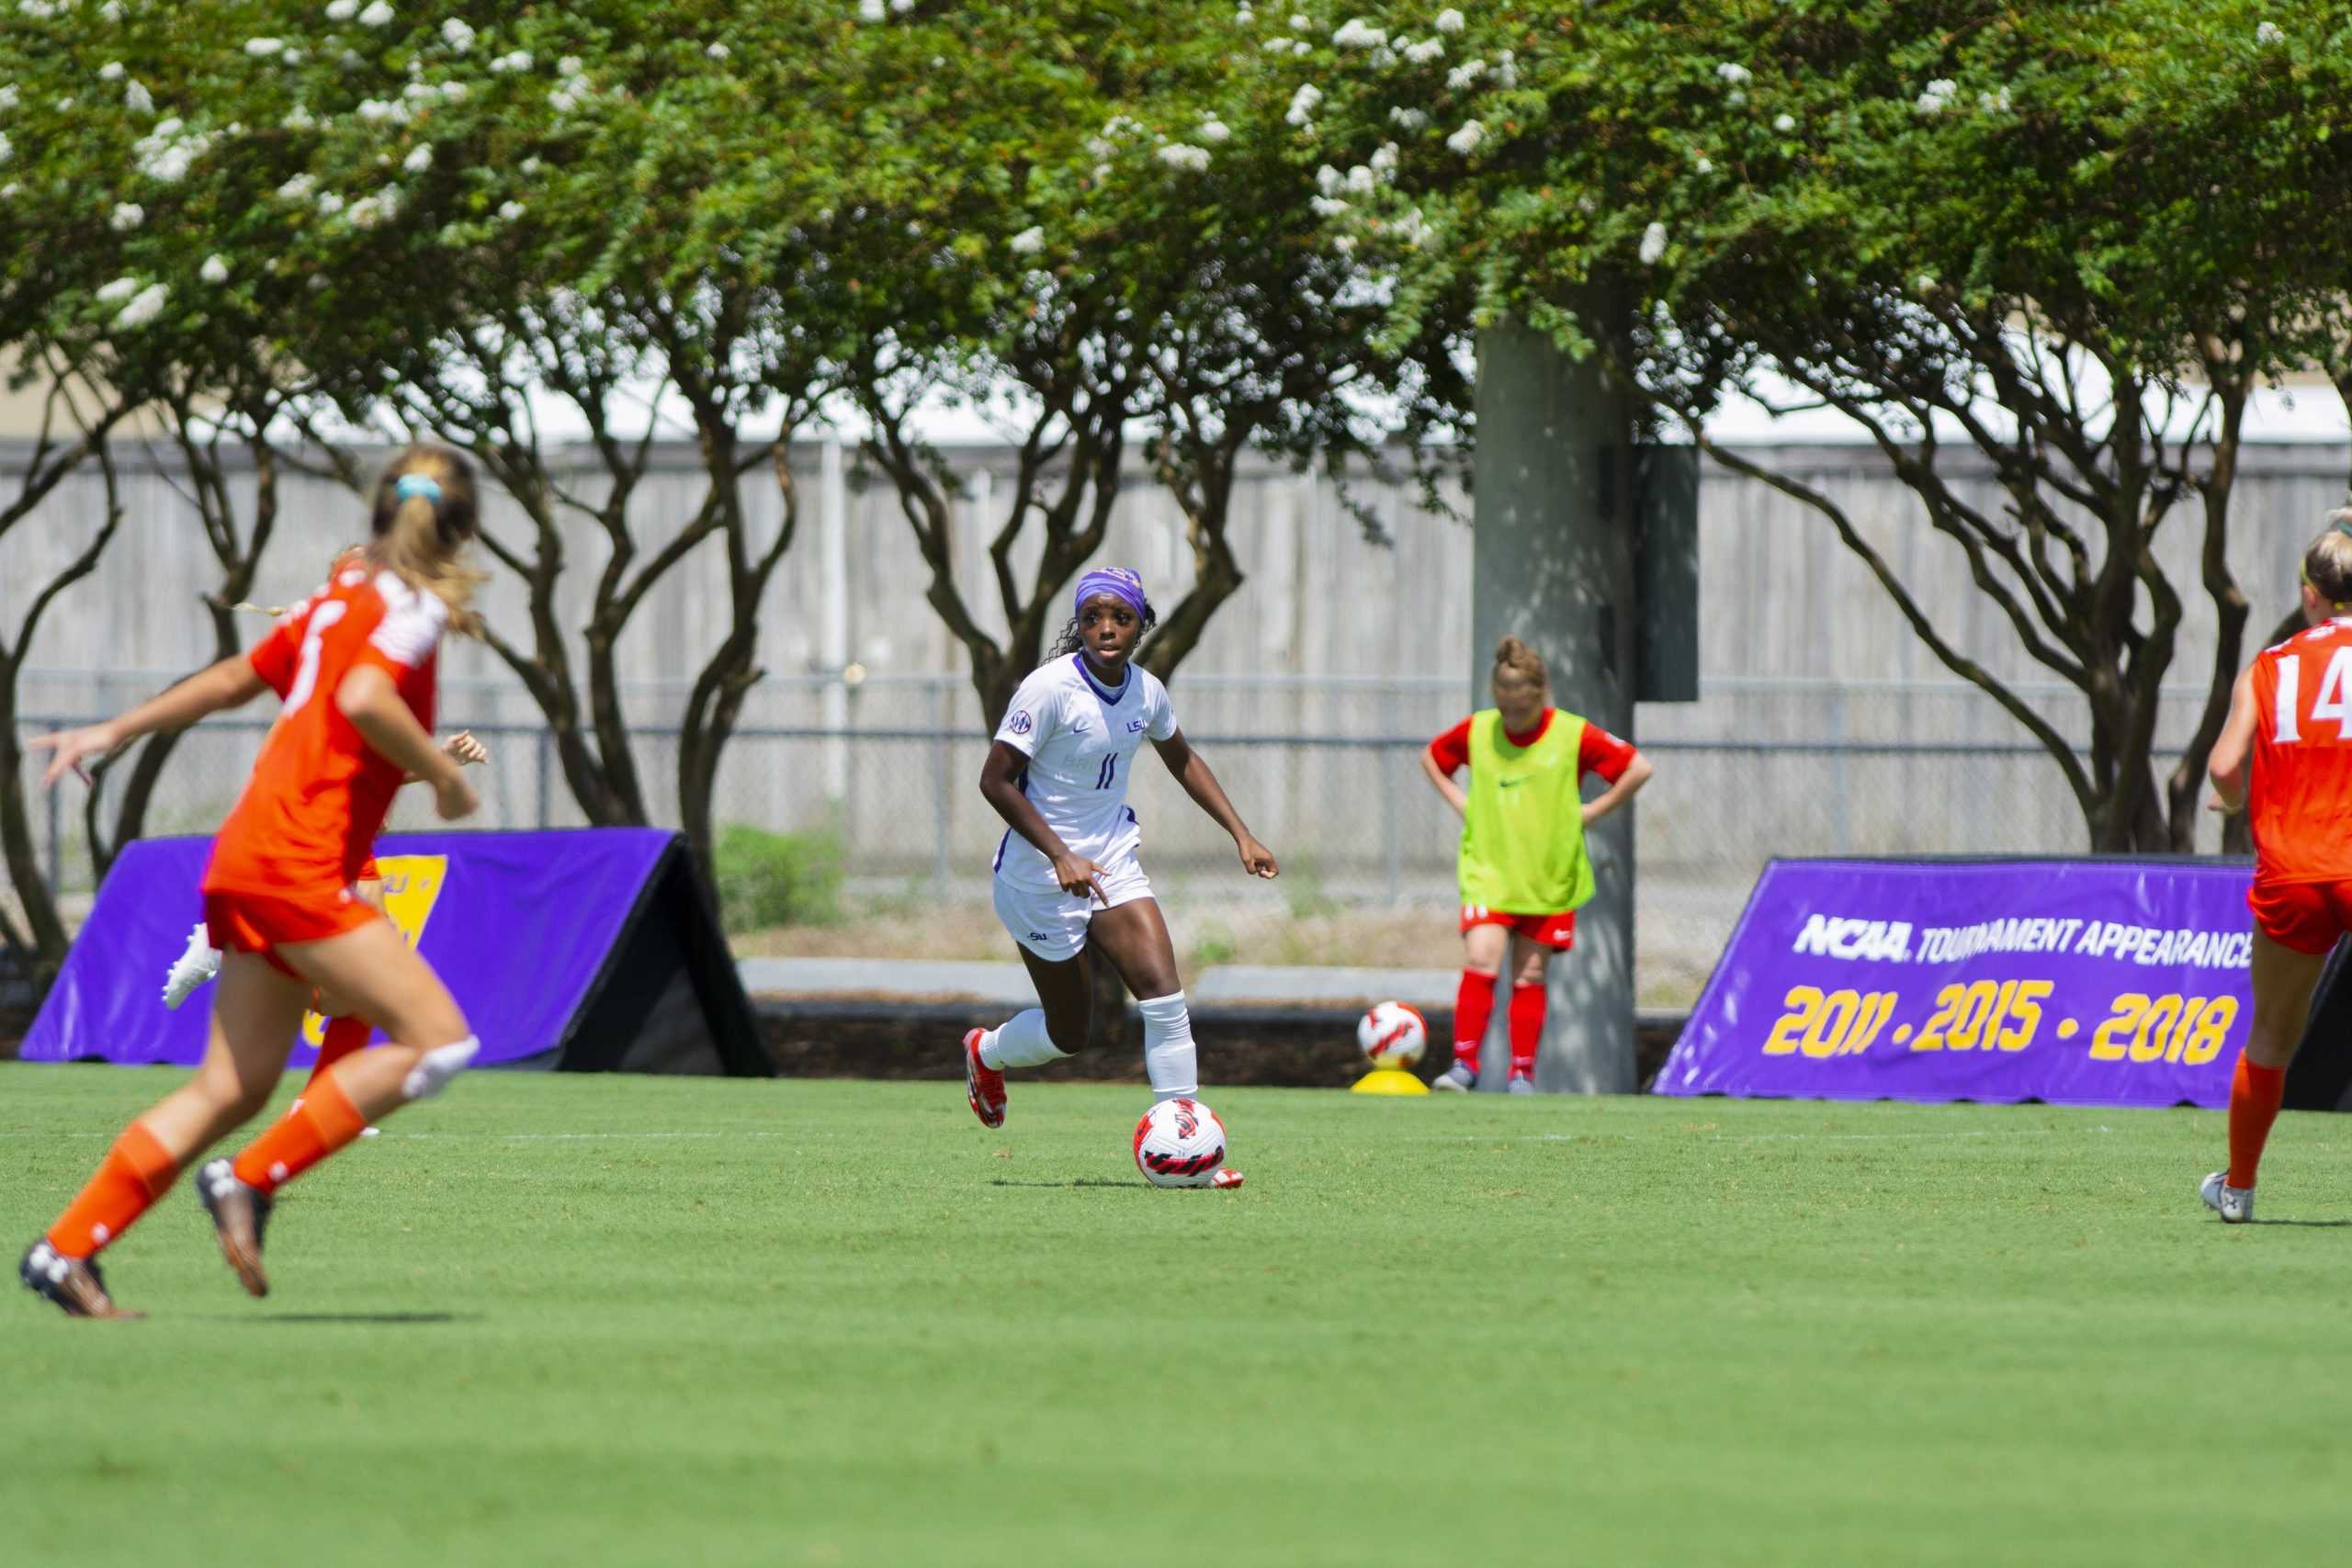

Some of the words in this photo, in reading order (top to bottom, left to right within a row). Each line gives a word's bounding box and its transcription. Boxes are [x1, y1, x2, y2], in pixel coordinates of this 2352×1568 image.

[2273, 646, 2352, 742] 14
[1095, 752, 1118, 790] 11
[1792, 914, 1913, 962] NCAA
[1916, 918, 2084, 964] TOURNAMENT
[1762, 985, 1899, 1058] 2011
[1909, 979, 2054, 1052] 2015
[2088, 992, 2239, 1066] 2018
